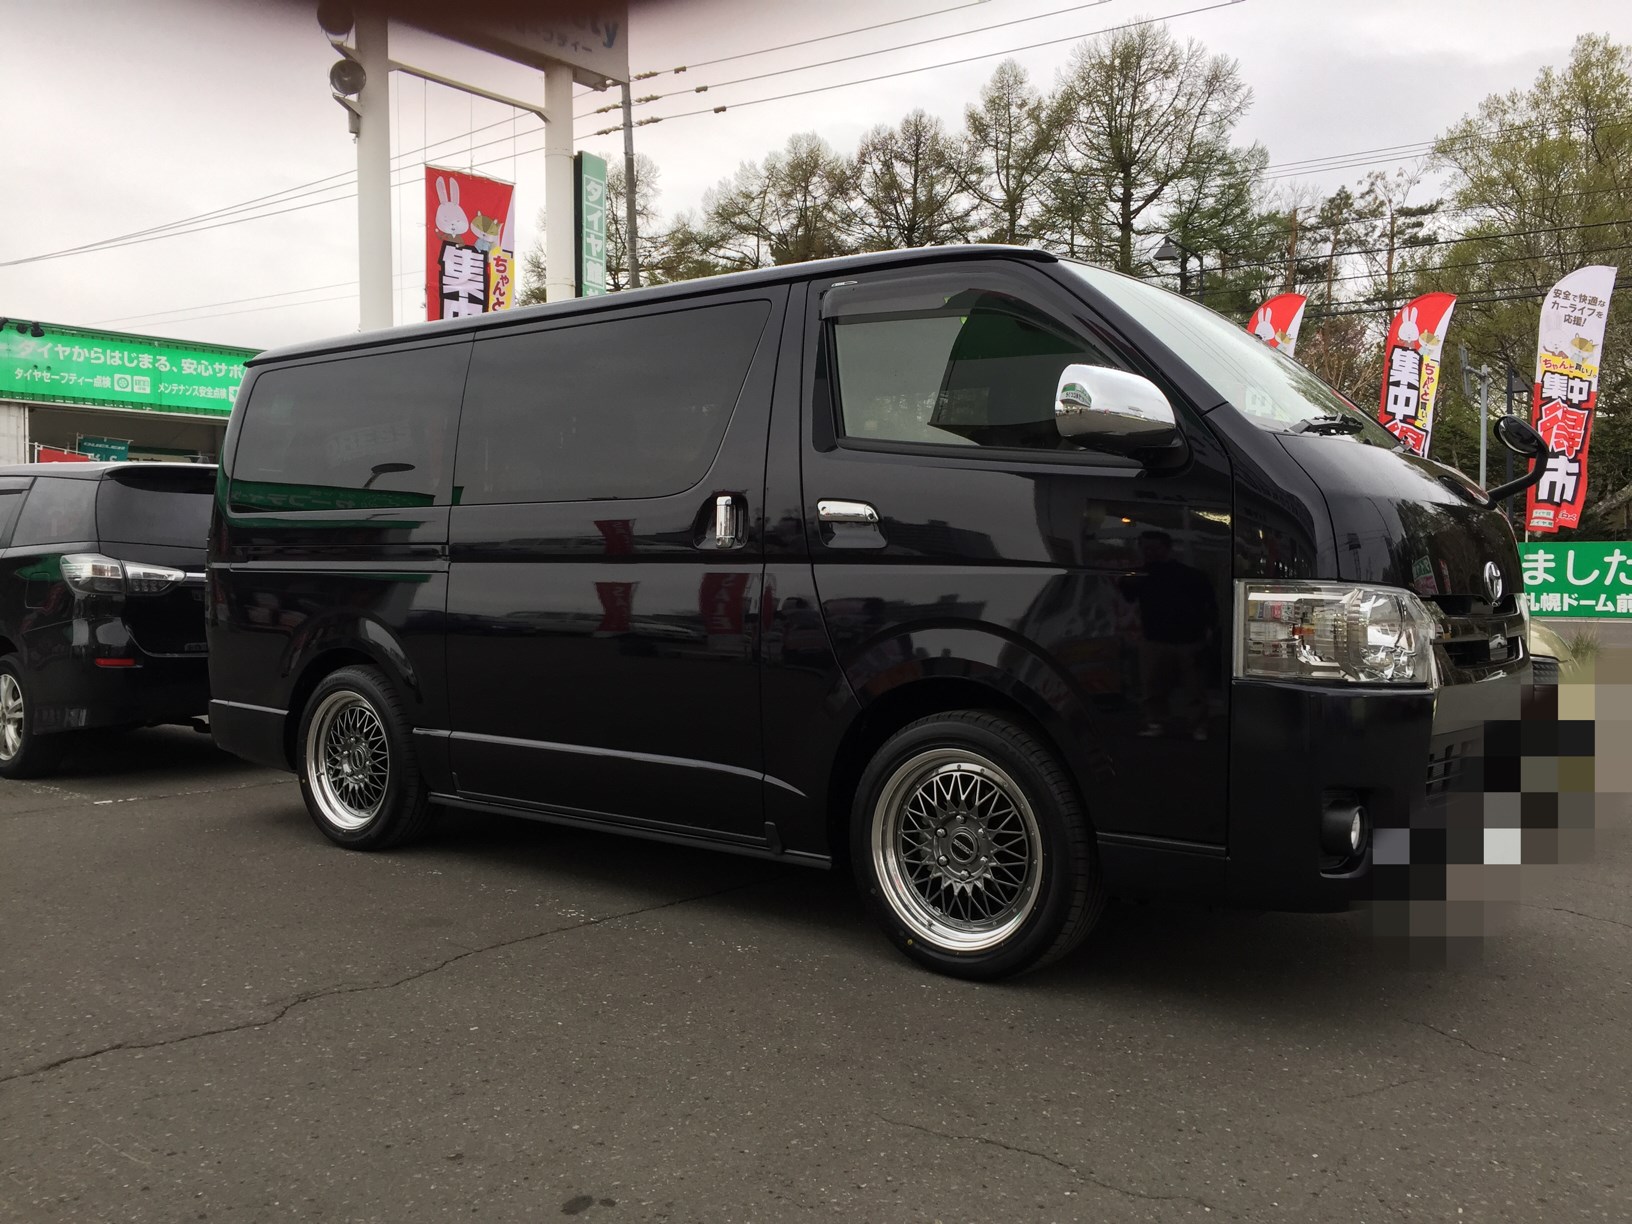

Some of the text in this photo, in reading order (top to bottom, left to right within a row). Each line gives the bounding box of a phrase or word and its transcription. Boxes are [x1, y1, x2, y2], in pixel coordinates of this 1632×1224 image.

[1553, 288, 1606, 307] 安全で快適な
[1551, 301, 1604, 319] カーライフを
[14, 367, 112, 389] タイヤセーフティー点検
[157, 383, 227, 400] メンテナンス安全点検
[1542, 373, 1590, 405] 集中
[1521, 548, 1632, 586] ました
